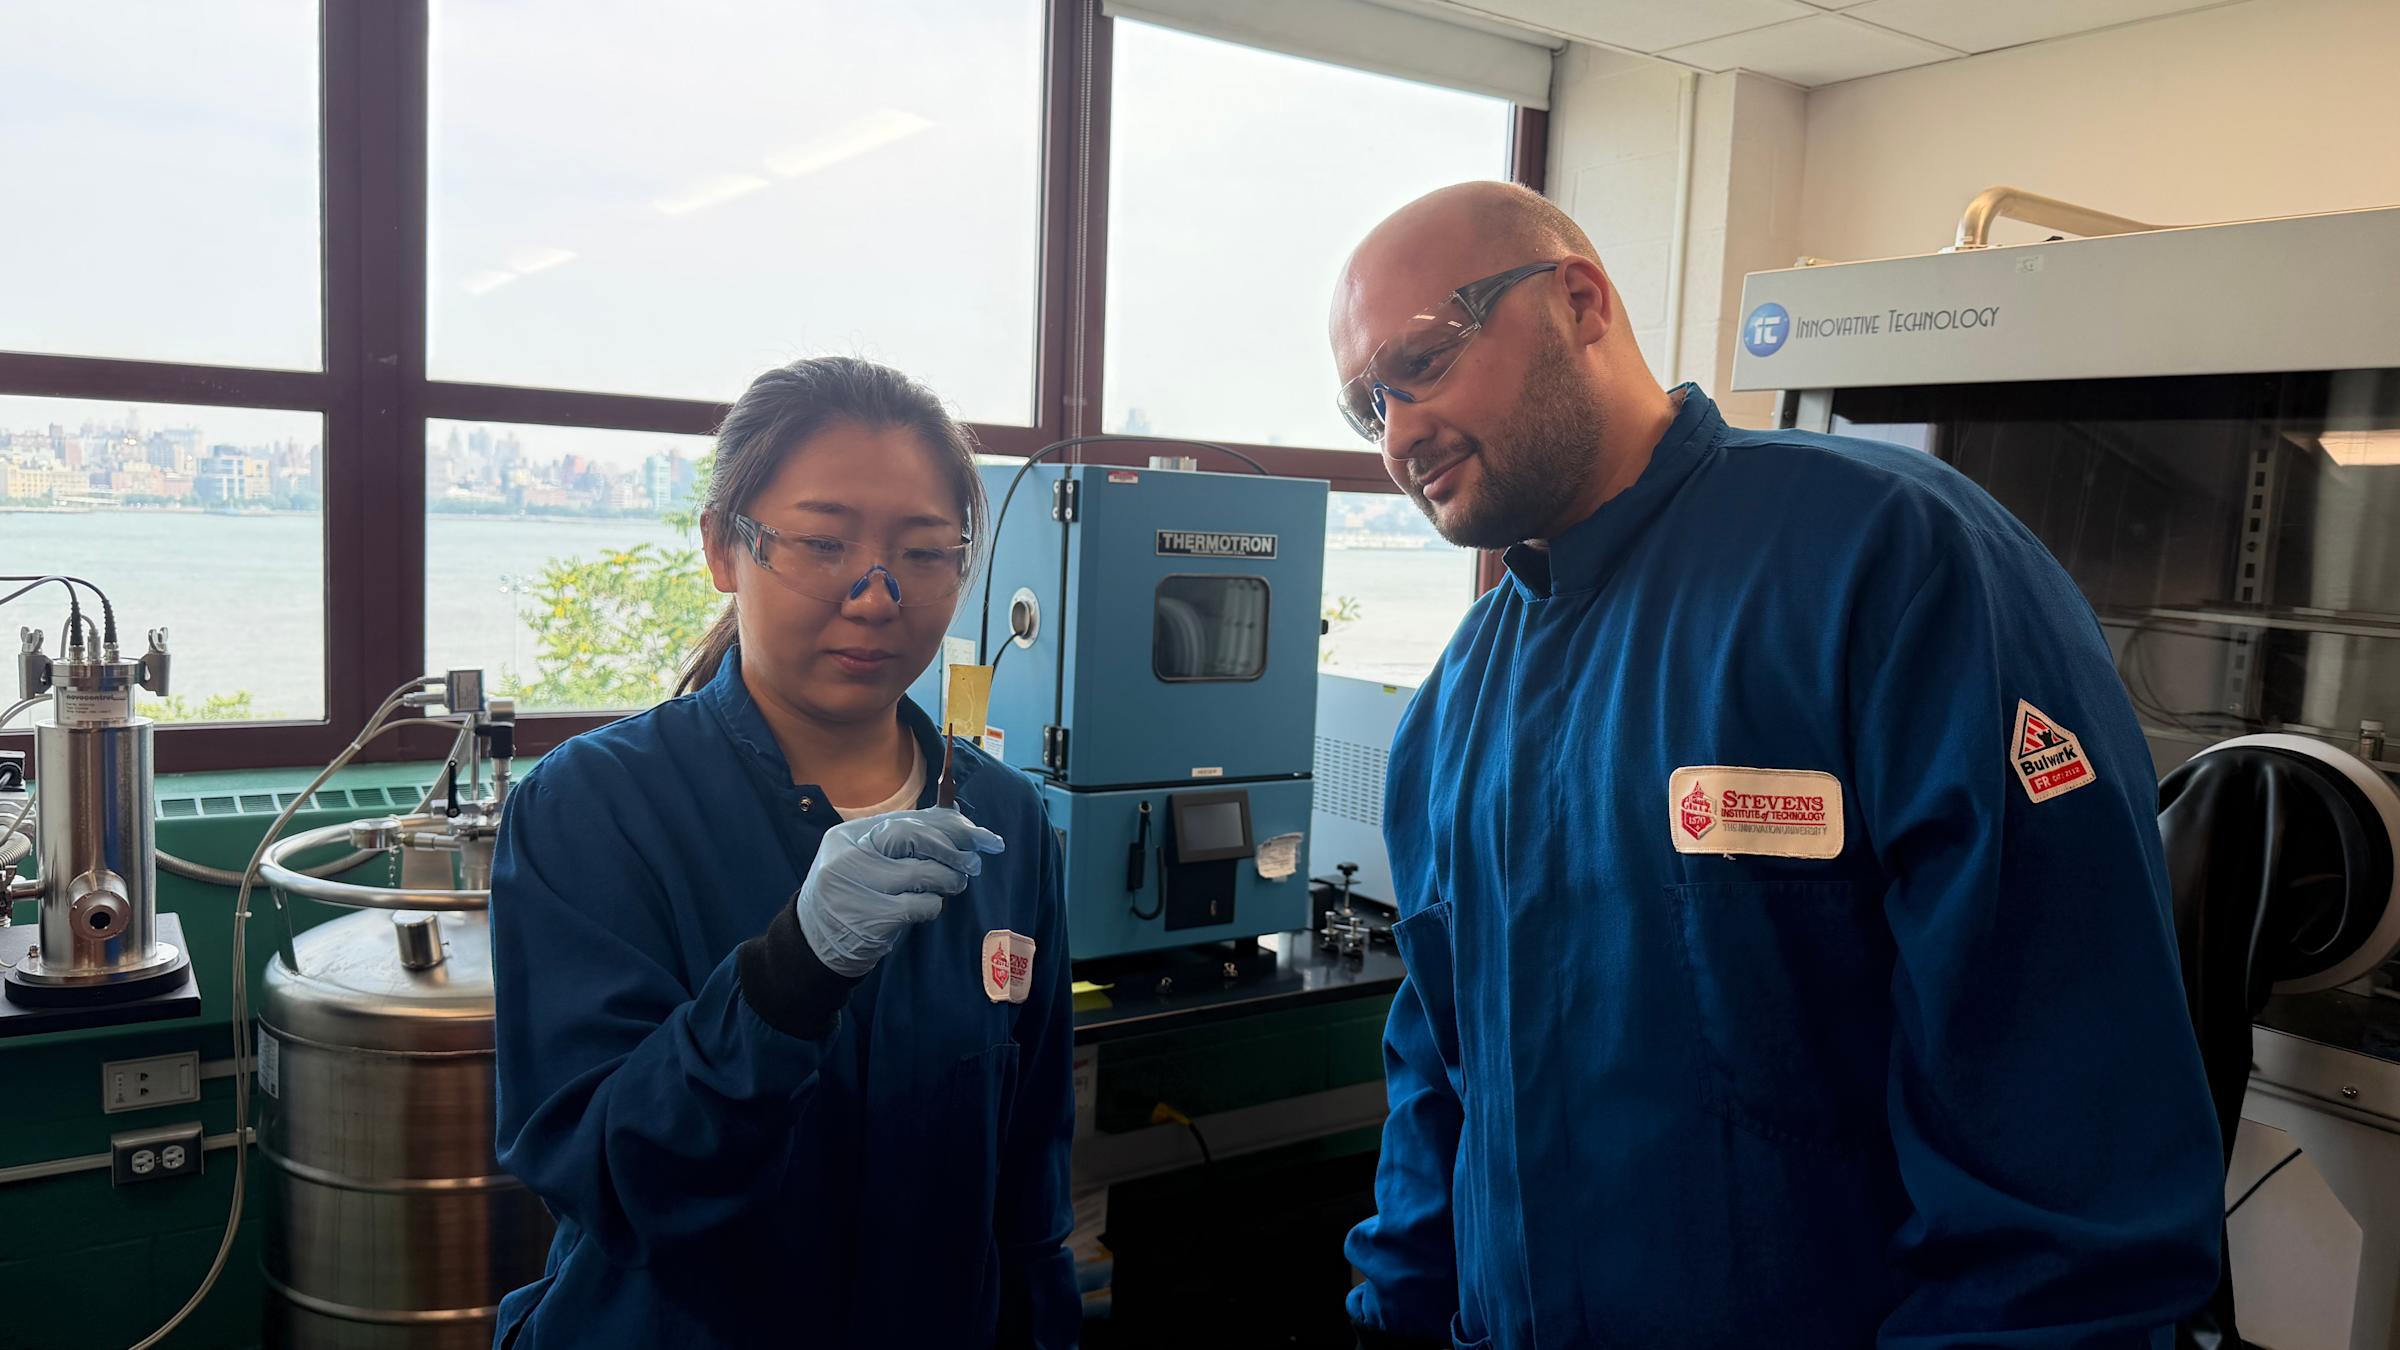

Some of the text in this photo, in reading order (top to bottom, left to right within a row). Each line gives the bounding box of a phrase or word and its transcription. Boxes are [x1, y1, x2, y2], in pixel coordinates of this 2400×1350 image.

[1795, 306, 2000, 339] INNOVATIVE TECHNOLOGY
[1162, 533, 1273, 553] THERMOTRON
[2034, 776, 2052, 790] FR
[1722, 790, 1824, 811] STEVENS
[1721, 808, 1826, 822] INSTITUTE of TECHNOLOGY
